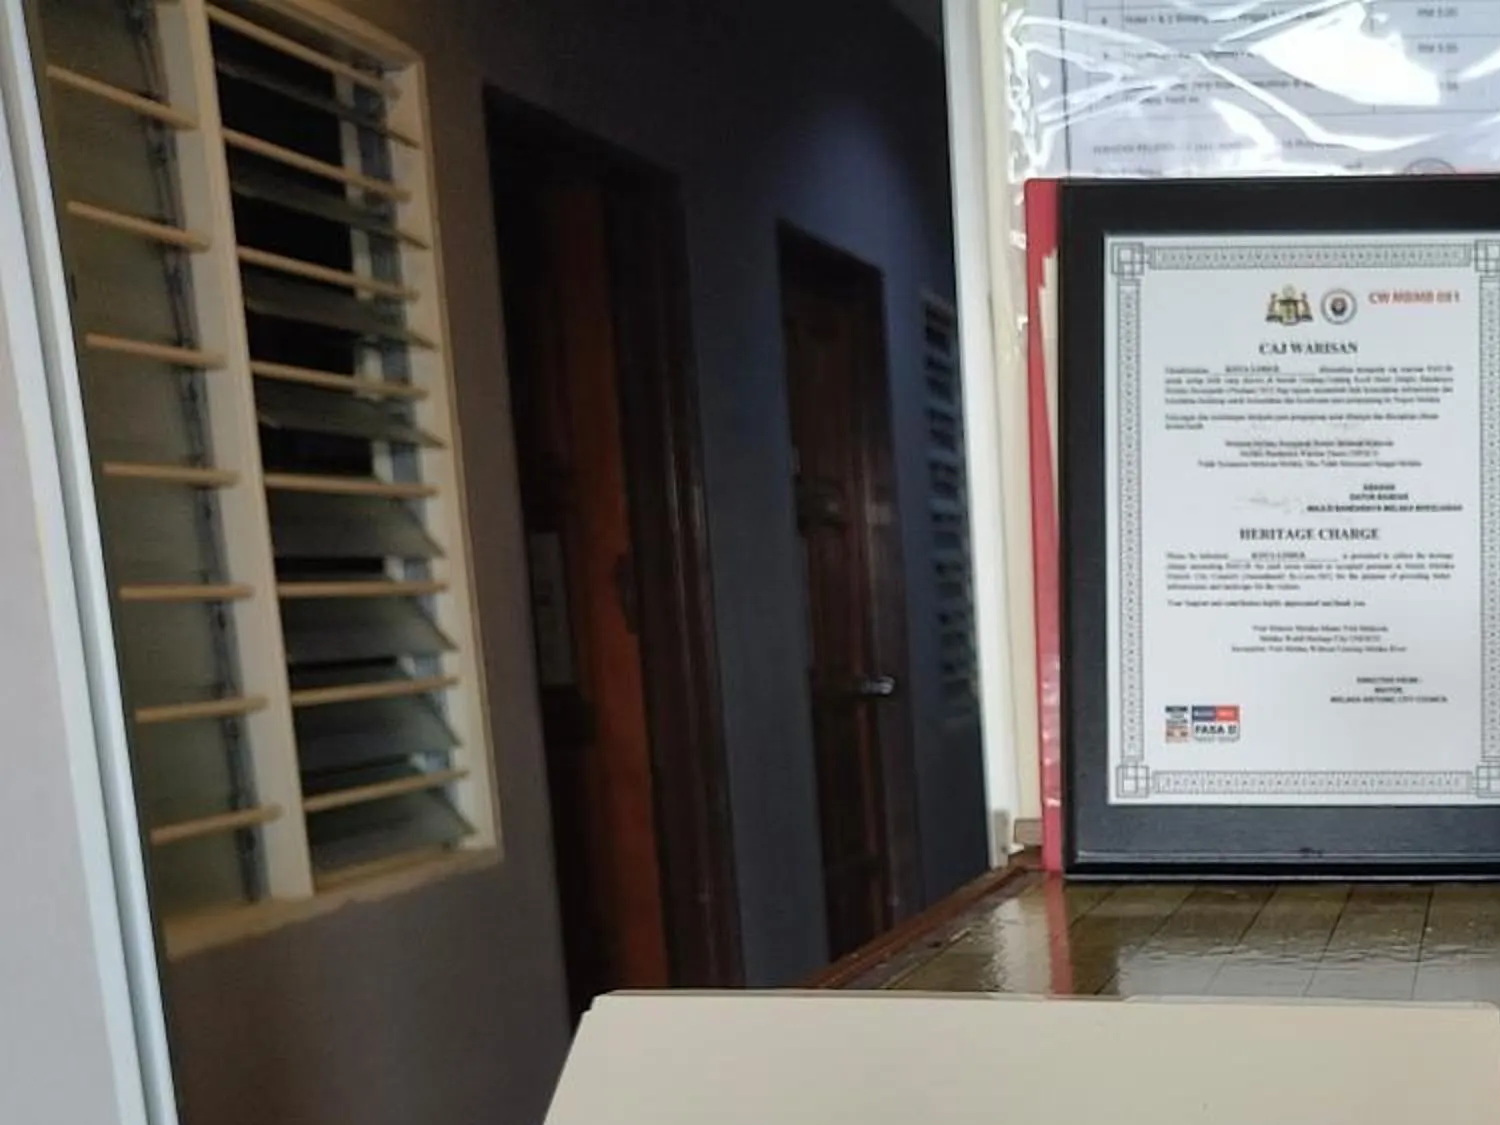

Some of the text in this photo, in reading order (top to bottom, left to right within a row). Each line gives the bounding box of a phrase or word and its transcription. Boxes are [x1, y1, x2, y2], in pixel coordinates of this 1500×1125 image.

[1258, 341, 1358, 355] CAJ WARISAN
[1239, 527, 1379, 541] HERITAGE CHARGE
